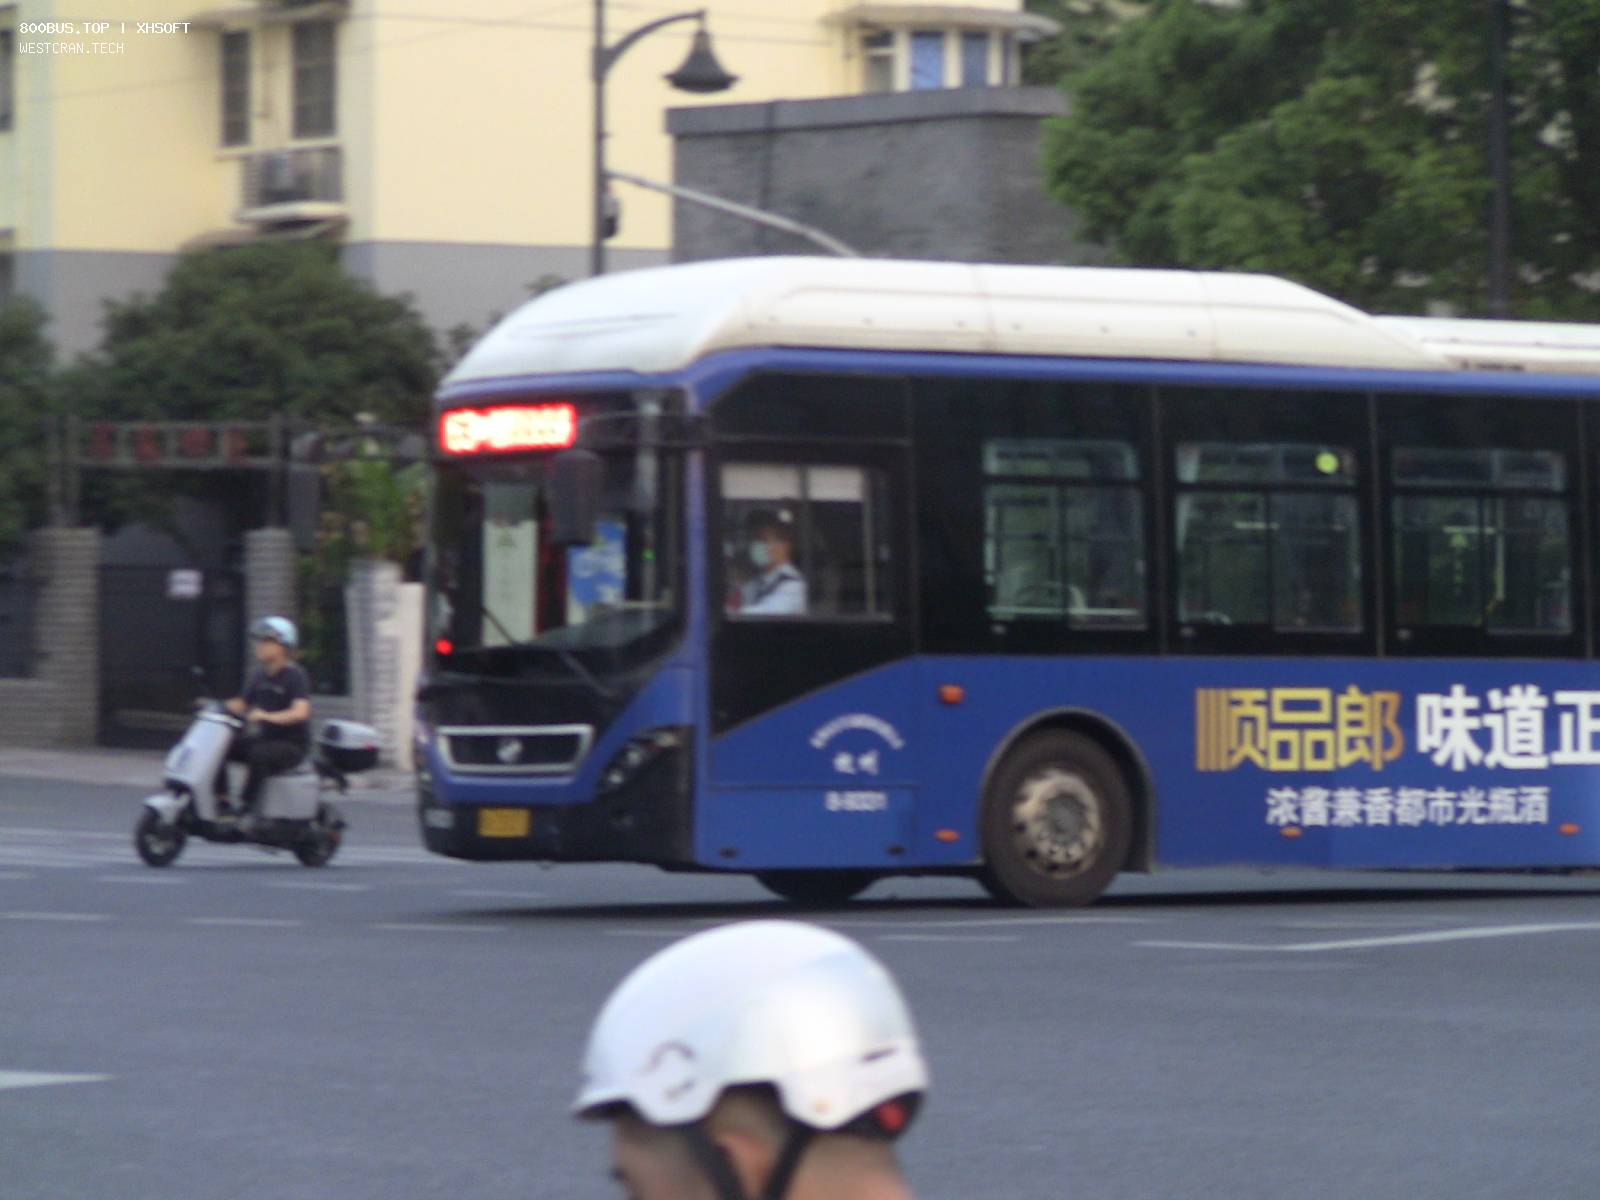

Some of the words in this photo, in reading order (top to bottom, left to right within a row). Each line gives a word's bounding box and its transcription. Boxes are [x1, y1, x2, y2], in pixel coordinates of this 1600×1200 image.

[1195, 684, 1405, 772] 顺品郎
[1265, 786, 1551, 827] 浓酱兼香都市光瓶酒
